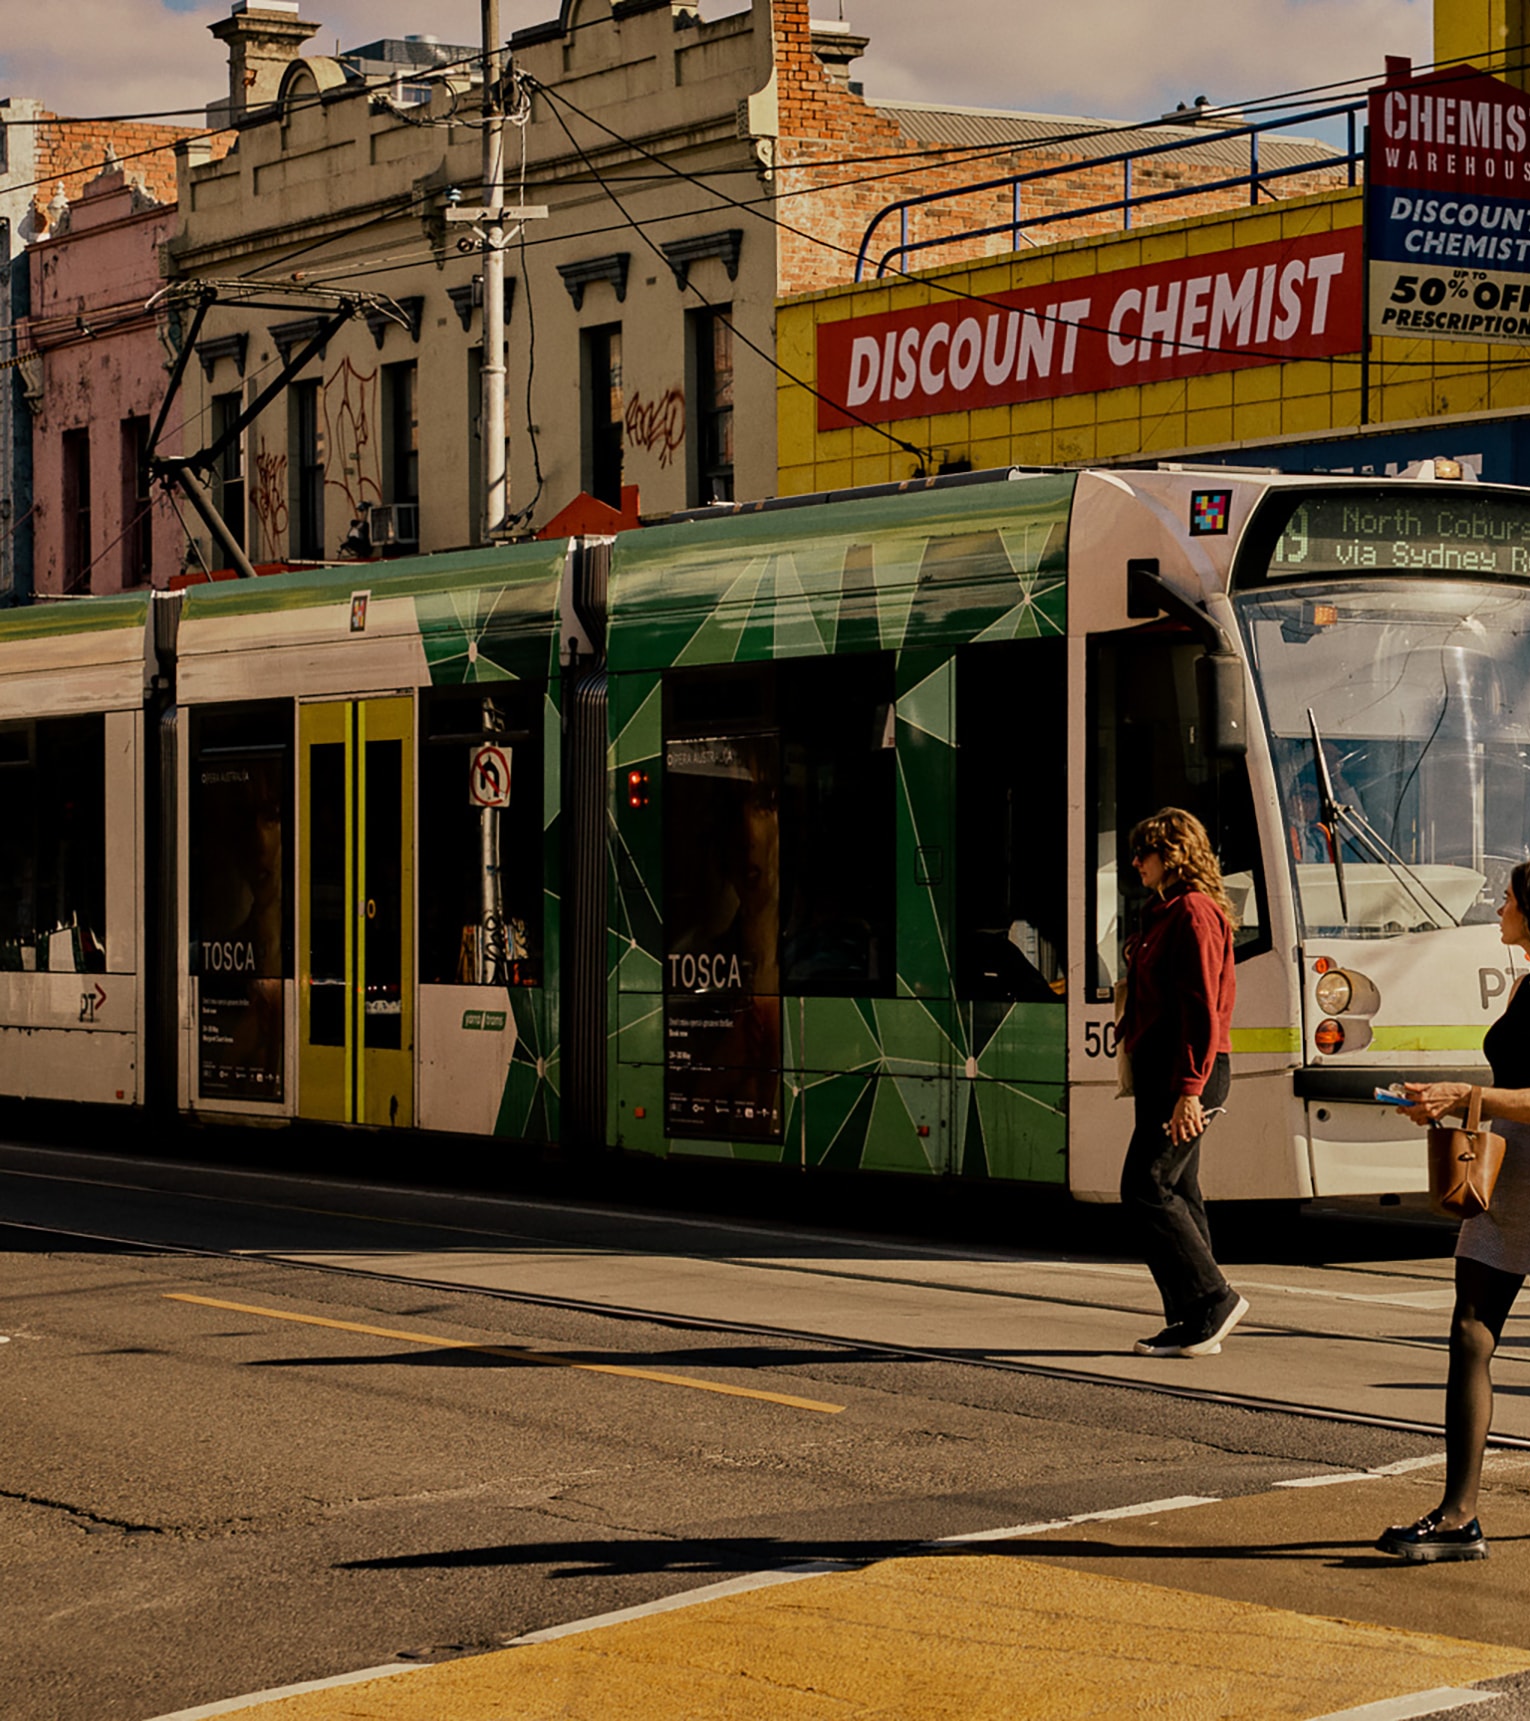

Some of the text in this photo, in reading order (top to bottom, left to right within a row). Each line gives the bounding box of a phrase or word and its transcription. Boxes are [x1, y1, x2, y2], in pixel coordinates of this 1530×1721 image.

[1453, 269, 1487, 281] UP TO
[846, 251, 1346, 408] DISCOUNT CHEMIST
[1341, 505, 1423, 537] North
[1335, 538, 1378, 566] via
[1391, 540, 1497, 572] Sydney
[201, 940, 257, 972] TOSCA
[667, 952, 743, 989] TOSCA
